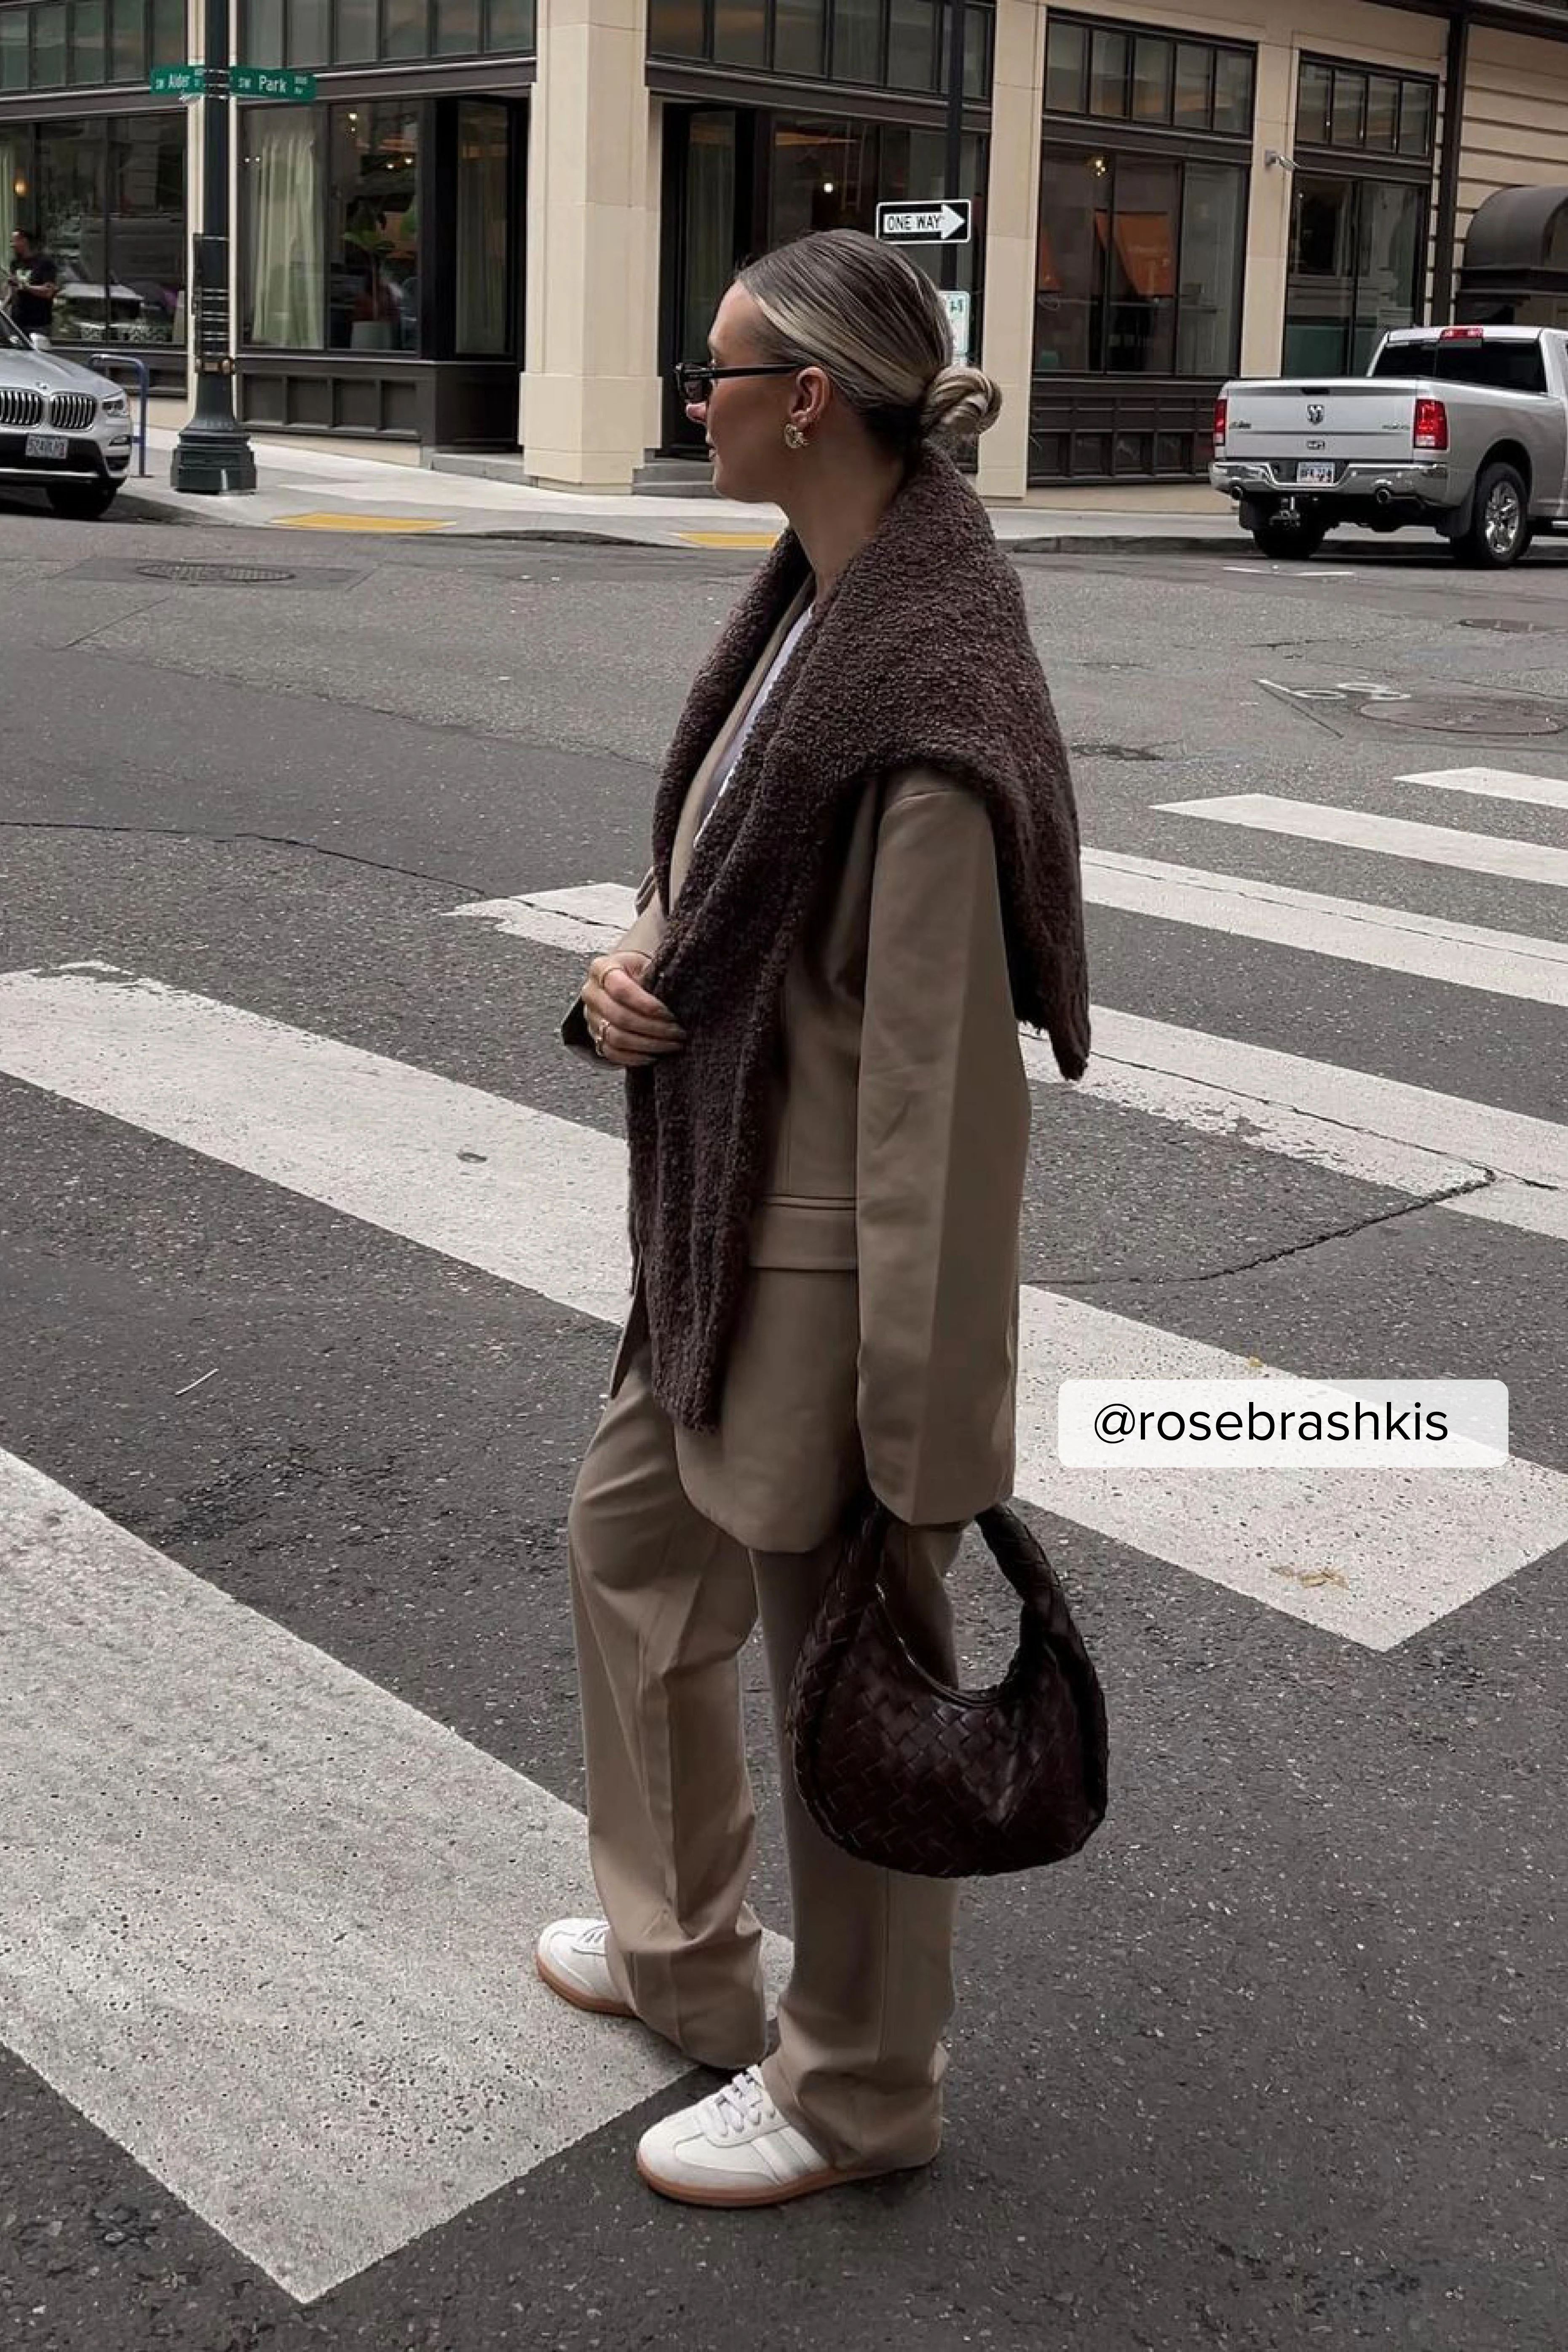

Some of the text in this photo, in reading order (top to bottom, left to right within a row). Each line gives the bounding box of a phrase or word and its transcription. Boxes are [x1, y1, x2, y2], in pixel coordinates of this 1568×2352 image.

[238, 78, 252, 88] SW
[258, 75, 287, 93] Park
[888, 215, 939, 231] ONE WAY
